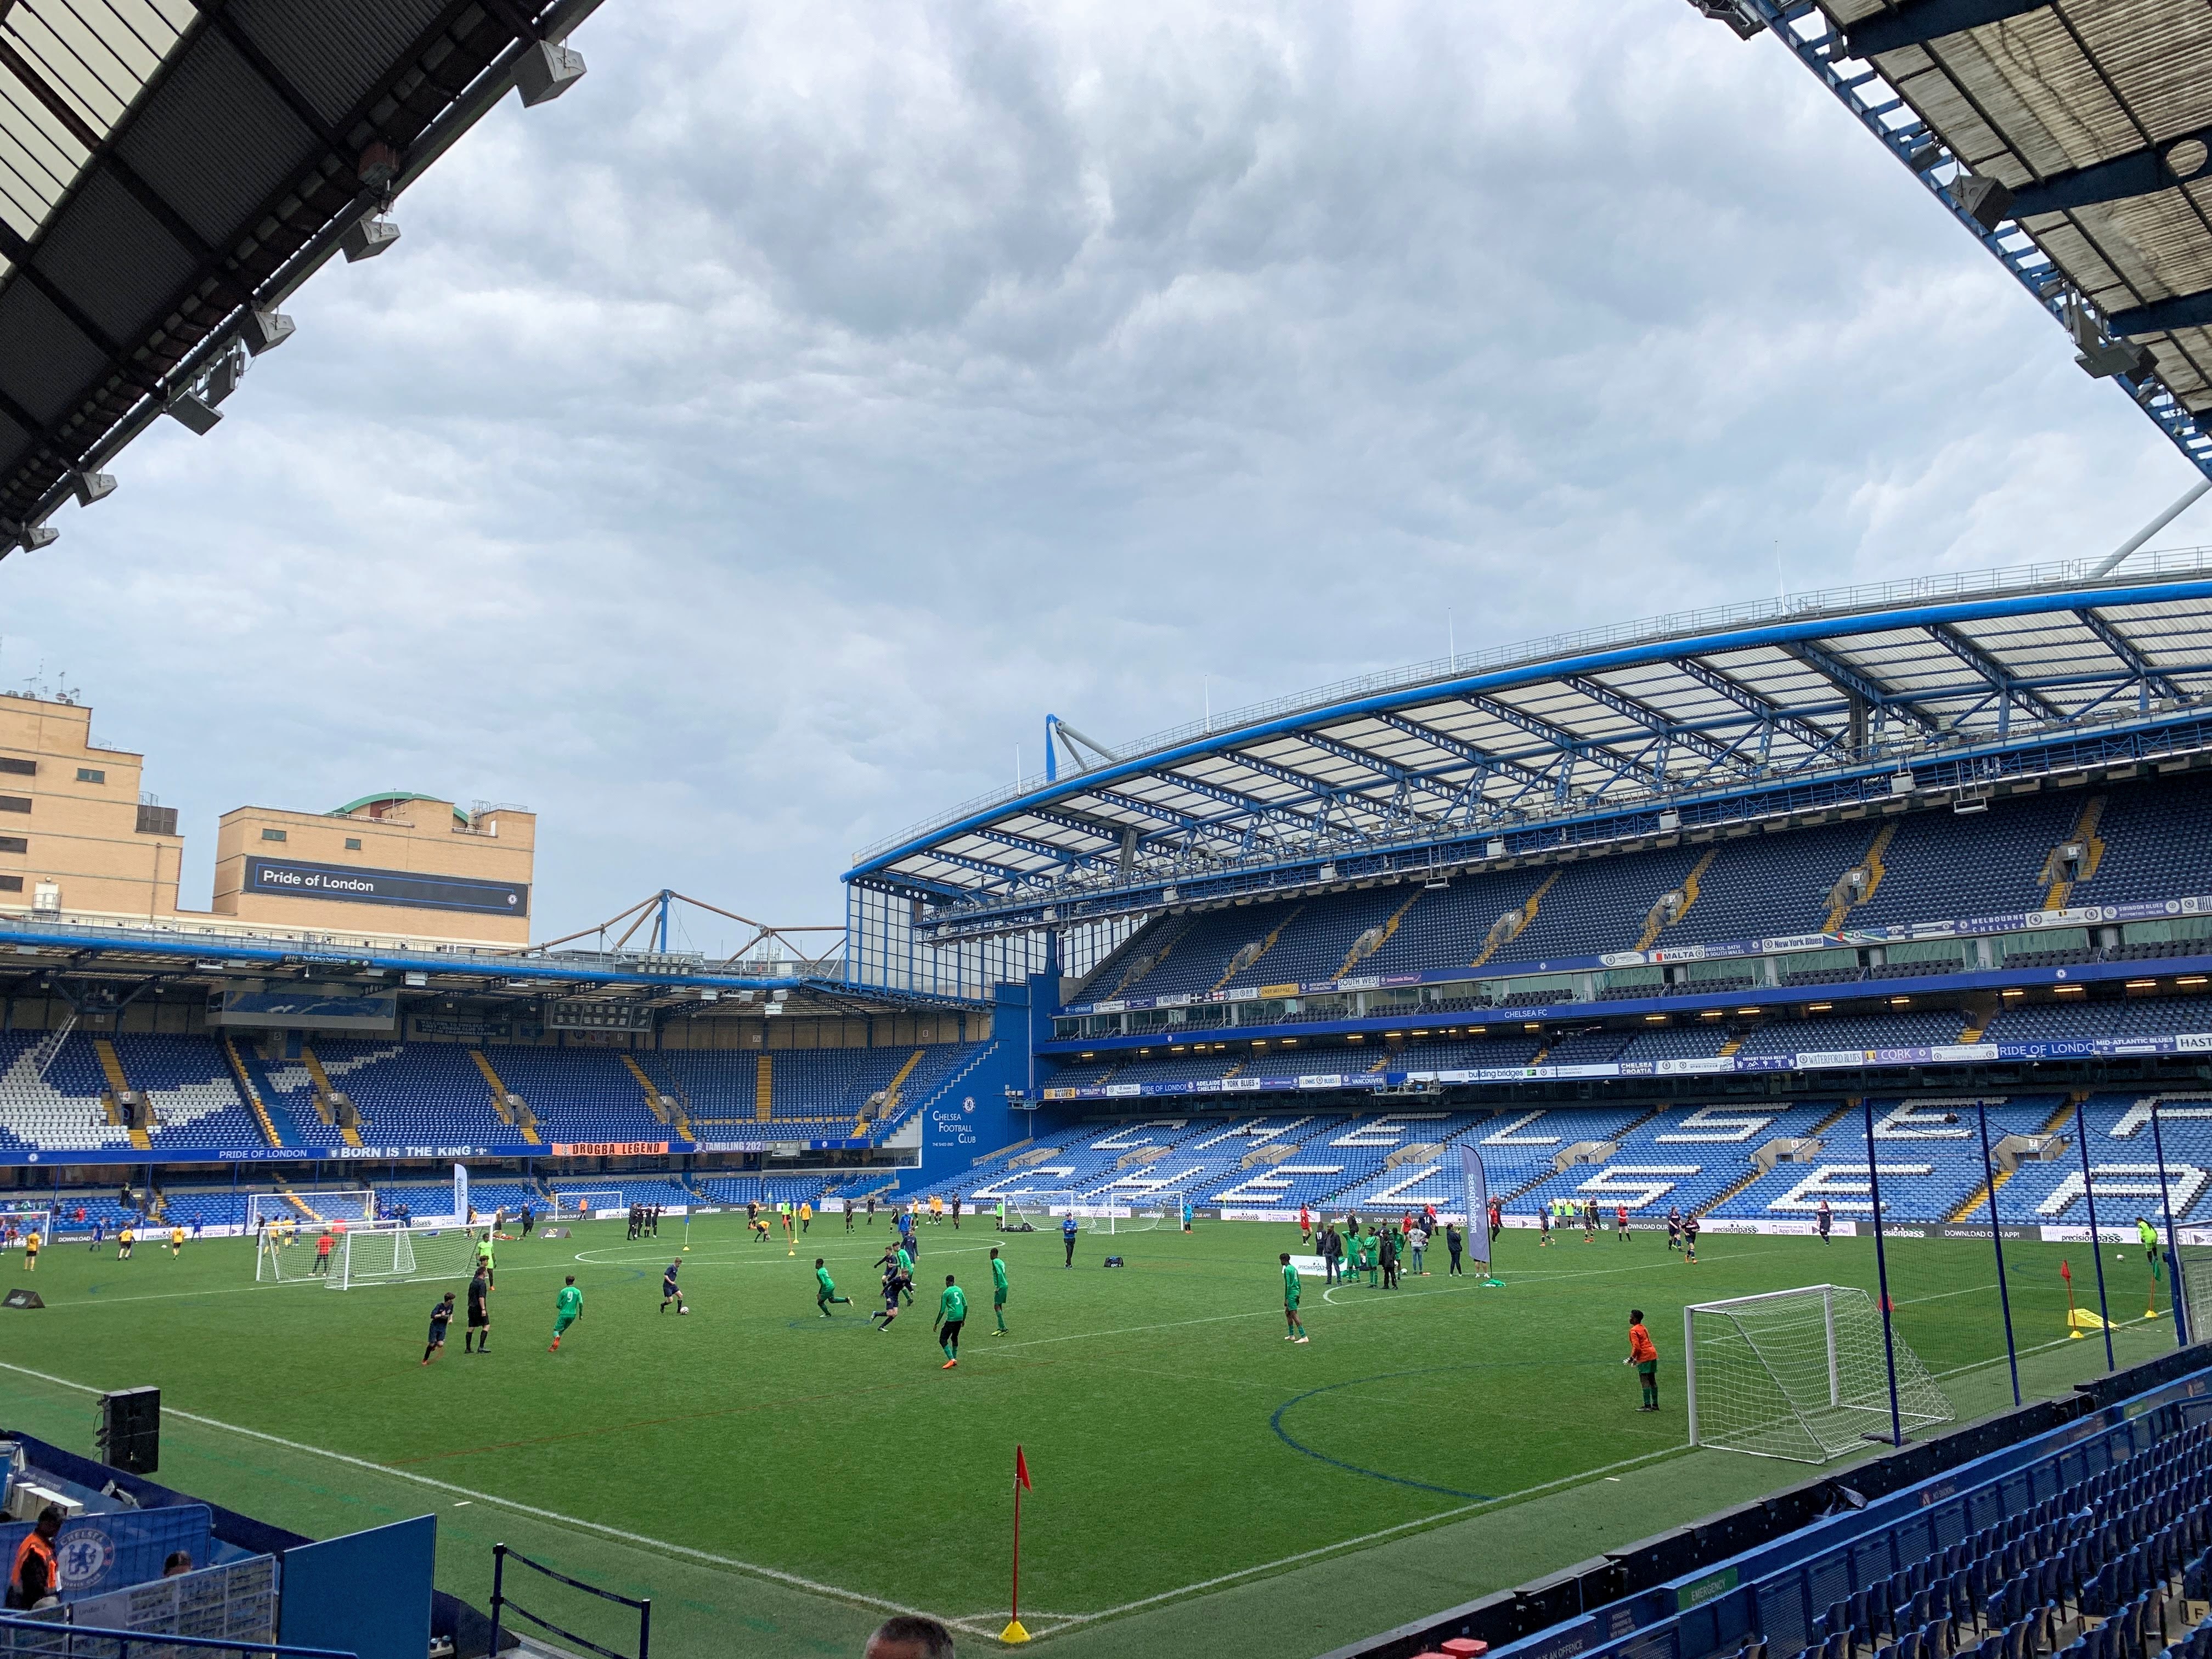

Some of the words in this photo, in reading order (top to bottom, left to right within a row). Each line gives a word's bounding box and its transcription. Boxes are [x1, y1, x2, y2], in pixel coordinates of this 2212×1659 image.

[263, 870, 301, 884] Pride
[305, 875, 319, 886] of
[323, 876, 374, 891] London
[1972, 914, 2024, 924] MELBOURNE
[1973, 923, 2025, 933] CHELSEA
[1664, 951, 1694, 960] MALTA
[1163, 995, 1172, 1003] SOUTH
[1504, 1010, 1536, 1018] CHELSEA
[2096, 1037, 2148, 1046] MID-ATLANTIC
[2181, 1037, 2212, 1047] HAST
[1998, 1045, 2027, 1055] RIDE
[2030, 1045, 2047, 1054] OF
[2052, 1042, 2095, 1053] LONDO
[1808, 1053, 1843, 1064] WATERFORD
[1844, 1053, 1861, 1063] BLUES
[1881, 1049, 1911, 1060] CORK
[1468, 1070, 1496, 1079] building
[1497, 1069, 1523, 1078] bridges
[933, 1110, 961, 1121] CHELSEA
[939, 1122, 972, 1132] FOOTBALL
[958, 1133, 976, 1143] CLUB
[341, 1147, 381, 1158] BORN
[386, 1147, 399, 1158] IS
[405, 1146, 432, 1156] THE
[438, 1146, 471, 1156] KING
[573, 1144, 615, 1154] DROGBA
[623, 1143, 659, 1154] LEGEND
[705, 1142, 744, 1152] TAMBLING
[746, 1142, 761, 1150] 202
[1316, 1232, 1322, 1240] 19
[567, 1291, 573, 1302] 9
[953, 1291, 960, 1305] 5
[1691, 1578, 1725, 1601] EMERGENCY
[1550, 1648, 1558, 1658] AN
[1558, 1639, 1583, 1657] OFFENCE
